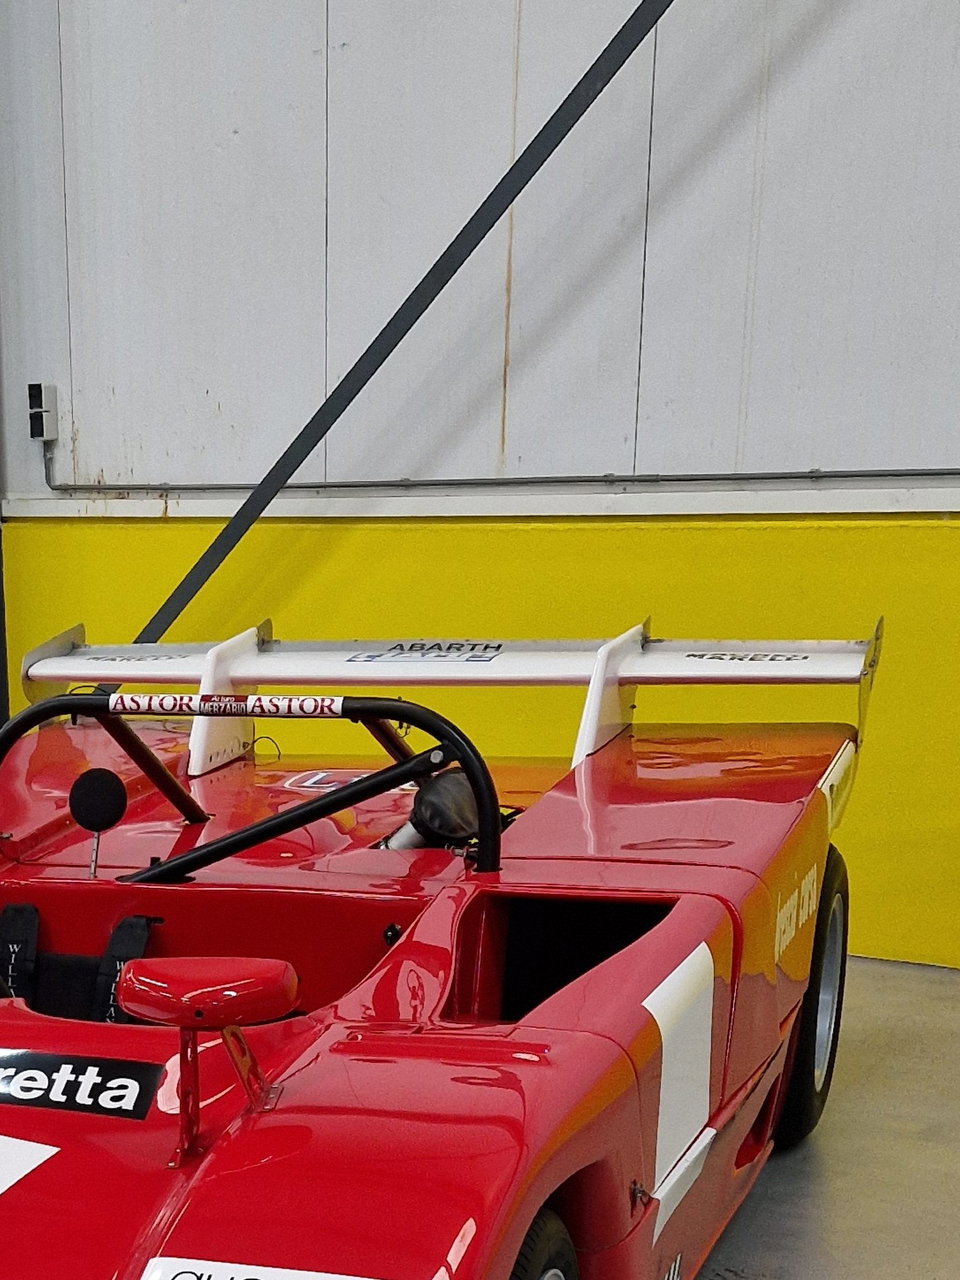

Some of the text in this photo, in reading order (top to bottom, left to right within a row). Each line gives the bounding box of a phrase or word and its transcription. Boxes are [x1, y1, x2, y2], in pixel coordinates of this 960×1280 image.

[386, 643, 504, 652] ABARTH
[112, 694, 197, 713] ASTOR
[200, 701, 247, 715] MERZARIO
[249, 695, 340, 715] ASTOR
